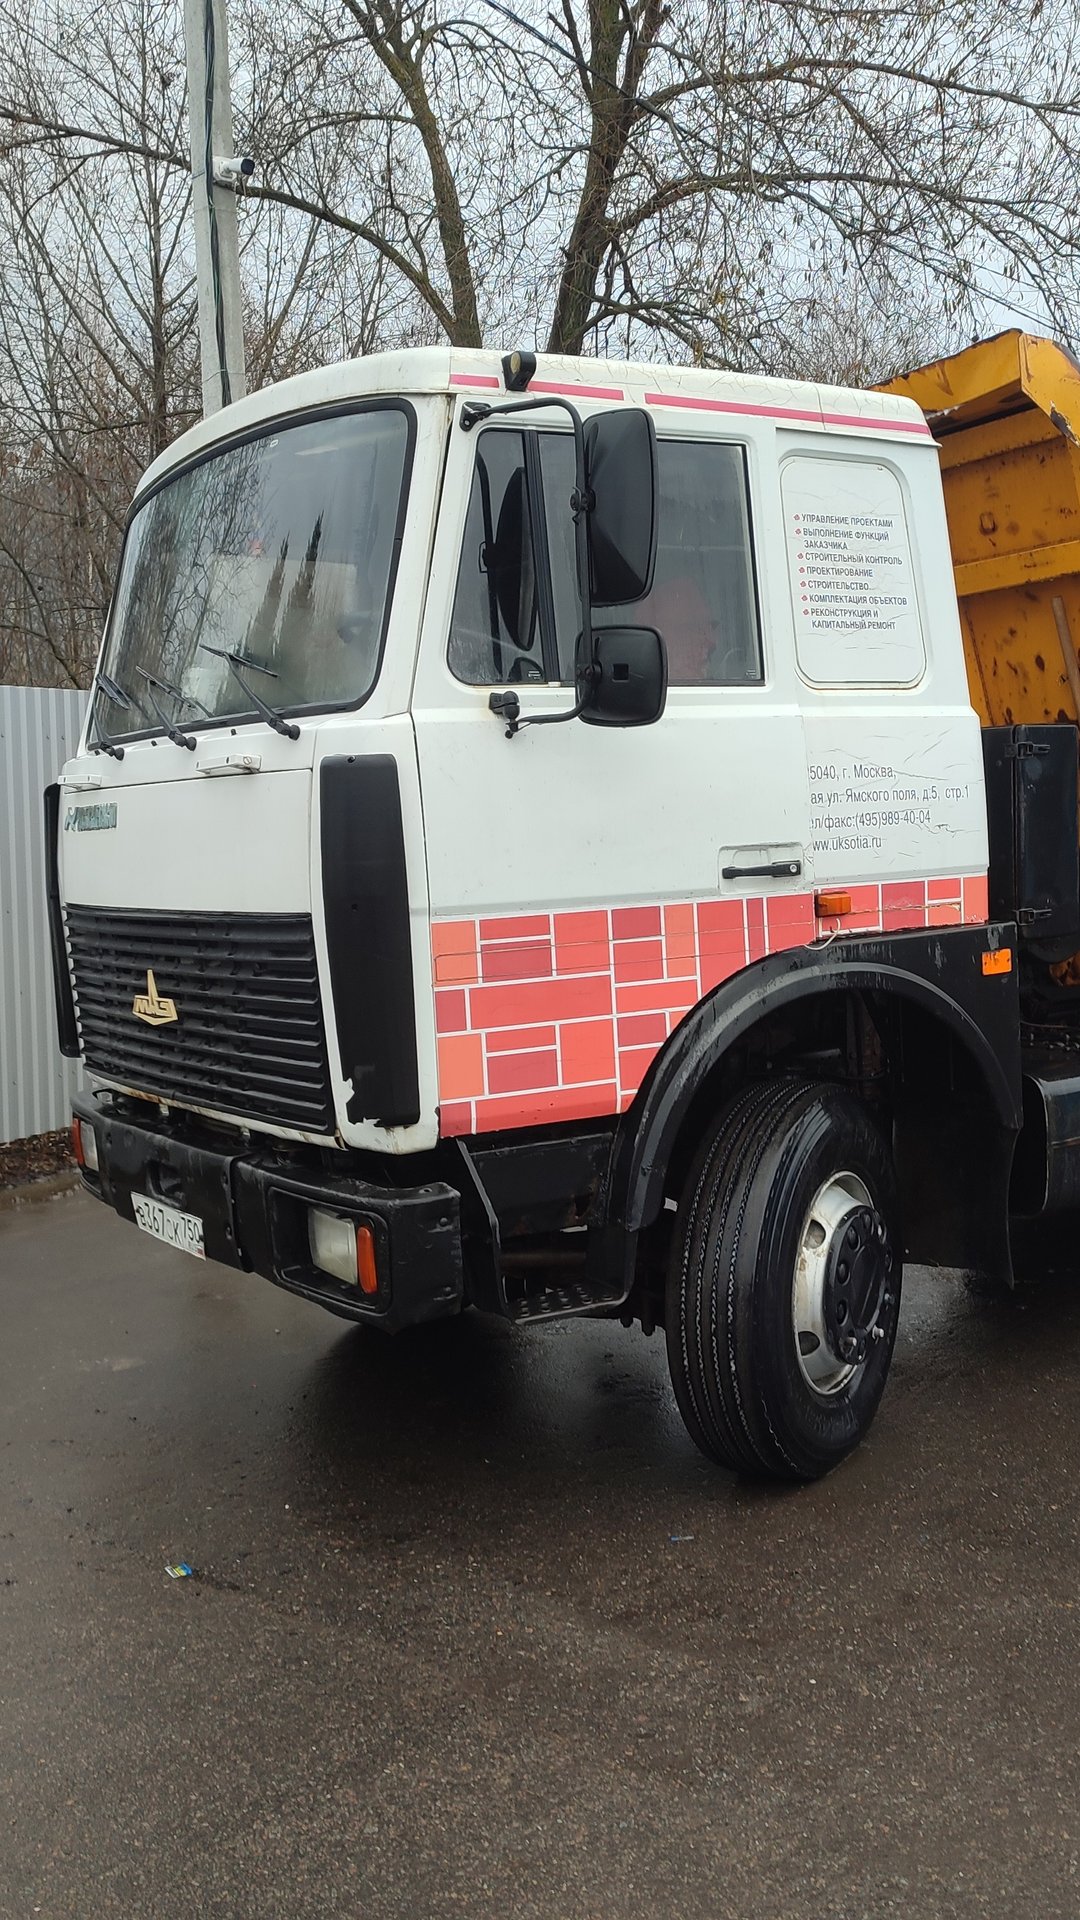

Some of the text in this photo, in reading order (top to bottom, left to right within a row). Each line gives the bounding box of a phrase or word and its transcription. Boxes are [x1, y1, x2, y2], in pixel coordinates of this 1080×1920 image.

[802, 513, 893, 528] УПРАВЛЕНИЕ ПРОЕКТАМИ
[803, 528, 889, 542] ВЫПОЛНЕНИЕ ФУНКЦИЙ
[804, 540, 848, 550] ЗАКАЗЧИКА
[805, 552, 903, 565] СТРОИТЕЛЬНЫЙ КОНТРОЛЬ
[806, 566, 873, 578] ПРОЕКТИРОВАНИЕ
[809, 594, 908, 606] КОМПЛЕКТАЦИЯ ОБЪЕКТОВ
[810, 608, 879, 619] РЕКОНСТРУКЦИЯ И
[812, 620, 896, 630] КАПИТАЛЬНЫЙ РЕМОНТ
[808, 764, 897, 781] 5040, г. Москва,
[845, 788, 890, 803] Ямского
[892, 788, 920, 803] поля,
[945, 784, 970, 802] стр.1
